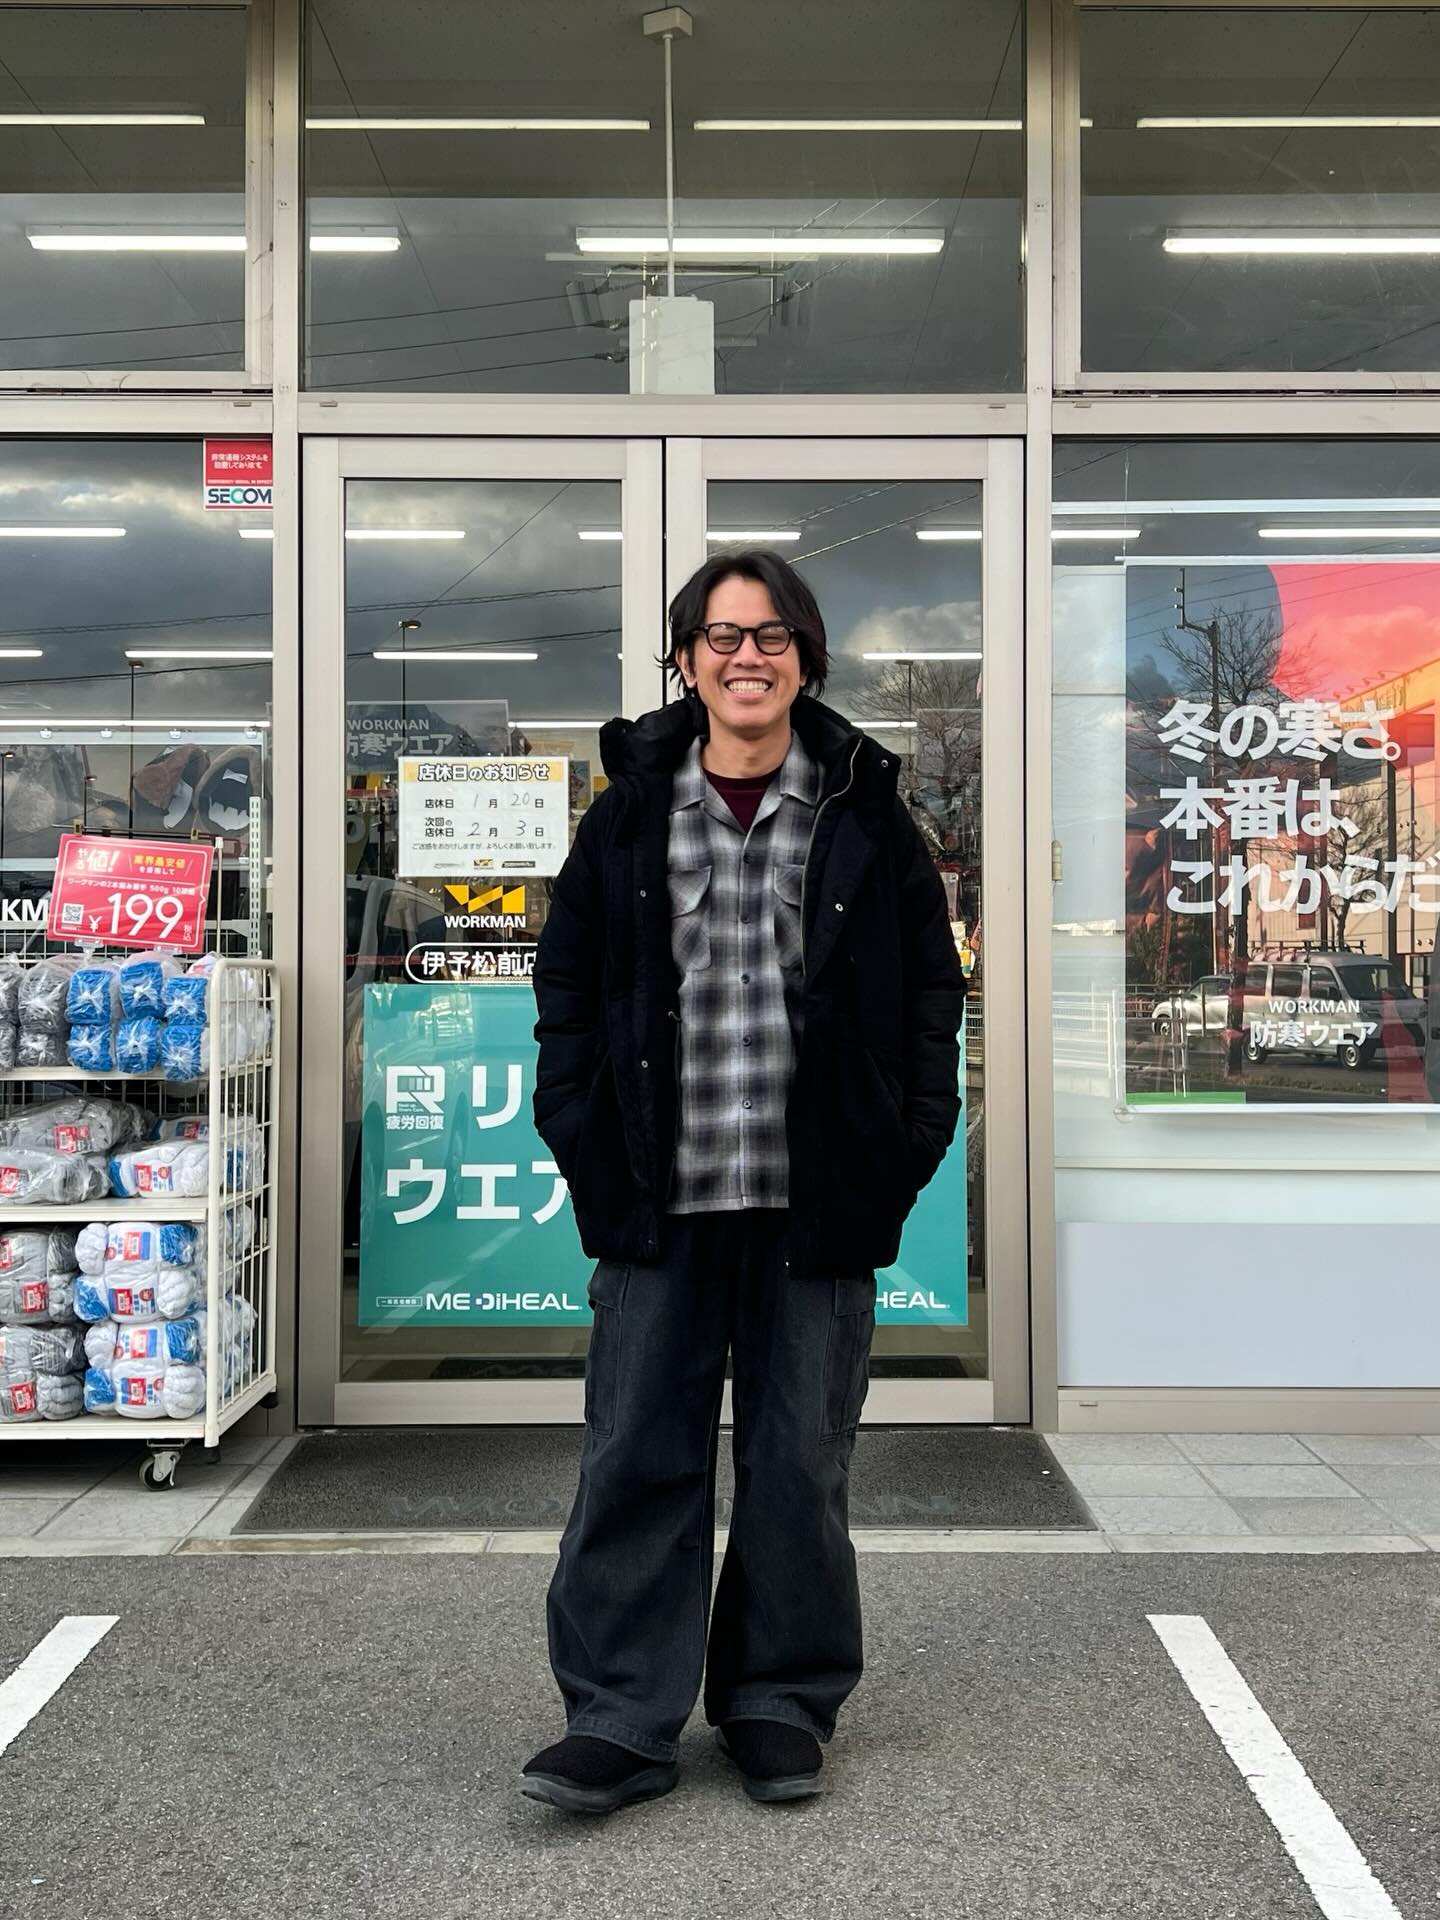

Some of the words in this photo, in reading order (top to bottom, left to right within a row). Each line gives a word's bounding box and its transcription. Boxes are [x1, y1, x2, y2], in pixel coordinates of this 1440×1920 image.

[208, 488, 272, 504] SECOM
[346, 719, 430, 731] WORKMAN
[1157, 699, 1401, 762] 冬の寒さ。
[418, 763, 550, 782] 店休日のお知らせ
[425, 798, 454, 809] 店休日
[488, 798, 498, 809] 月
[511, 791, 531, 807] 20
[535, 798, 544, 809] 日
[1159, 776, 1361, 841] 本番は、
[424, 816, 453, 827] 次回の
[425, 827, 454, 837] 店休日
[467, 821, 481, 837] 2
[488, 827, 498, 837] 月
[515, 819, 527, 837] 3
[535, 827, 544, 837] 日
[444, 915, 527, 928] WORKMAN
[1268, 1000, 1360, 1013] WORKMAN
[1249, 1019, 1378, 1048] 防寒ウエア
[386, 1115, 445, 1130] 疲労回復
